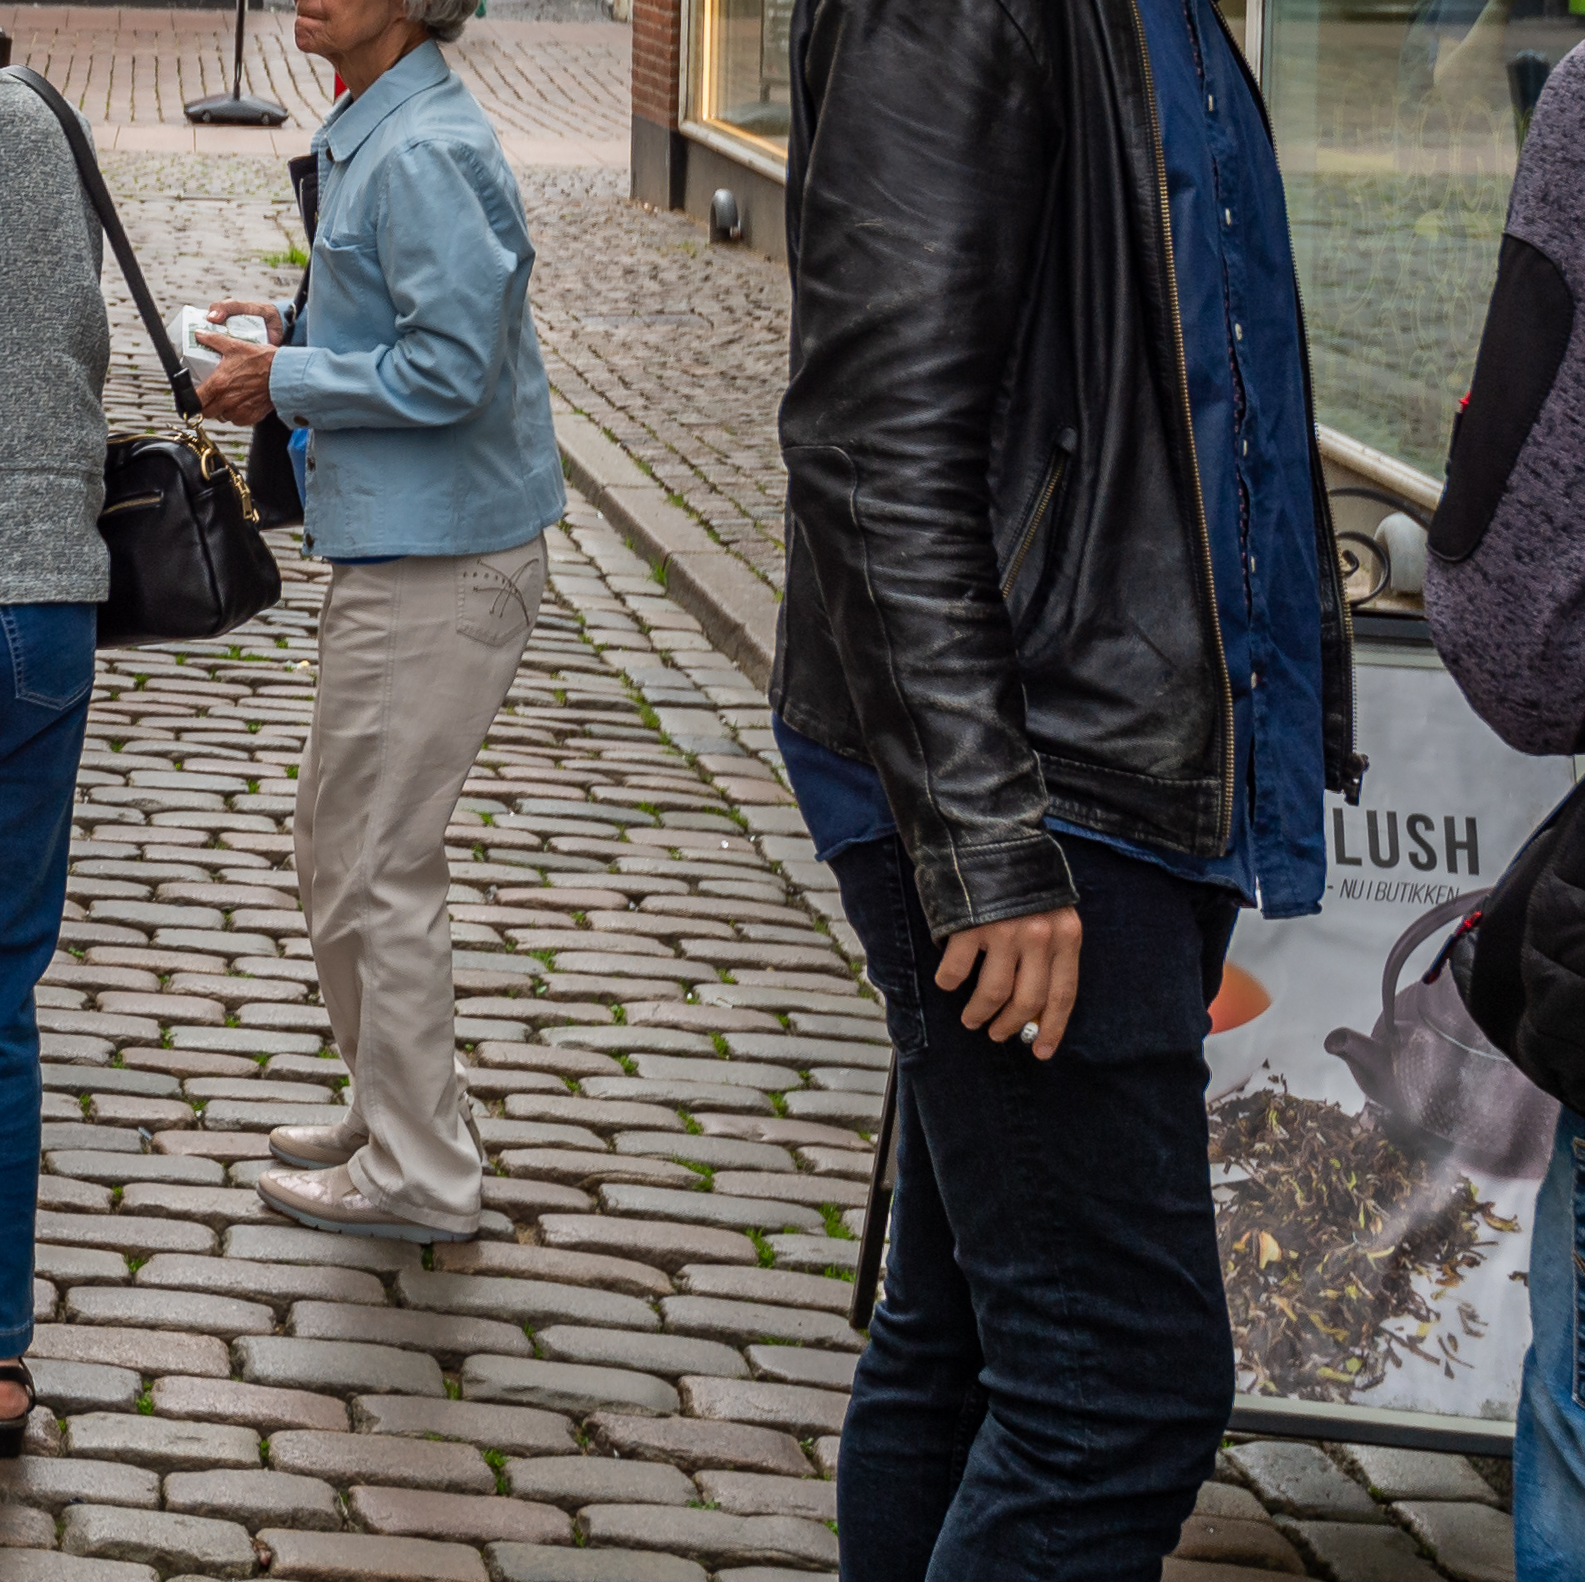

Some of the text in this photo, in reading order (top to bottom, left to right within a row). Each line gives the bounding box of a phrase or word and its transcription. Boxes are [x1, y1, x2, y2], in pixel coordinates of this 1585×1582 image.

[1332, 807, 1481, 876] LUSH
[1339, 878, 1364, 900] NU
[1366, 879, 1373, 901] I
[1374, 880, 1460, 906] BUTIKKEN
